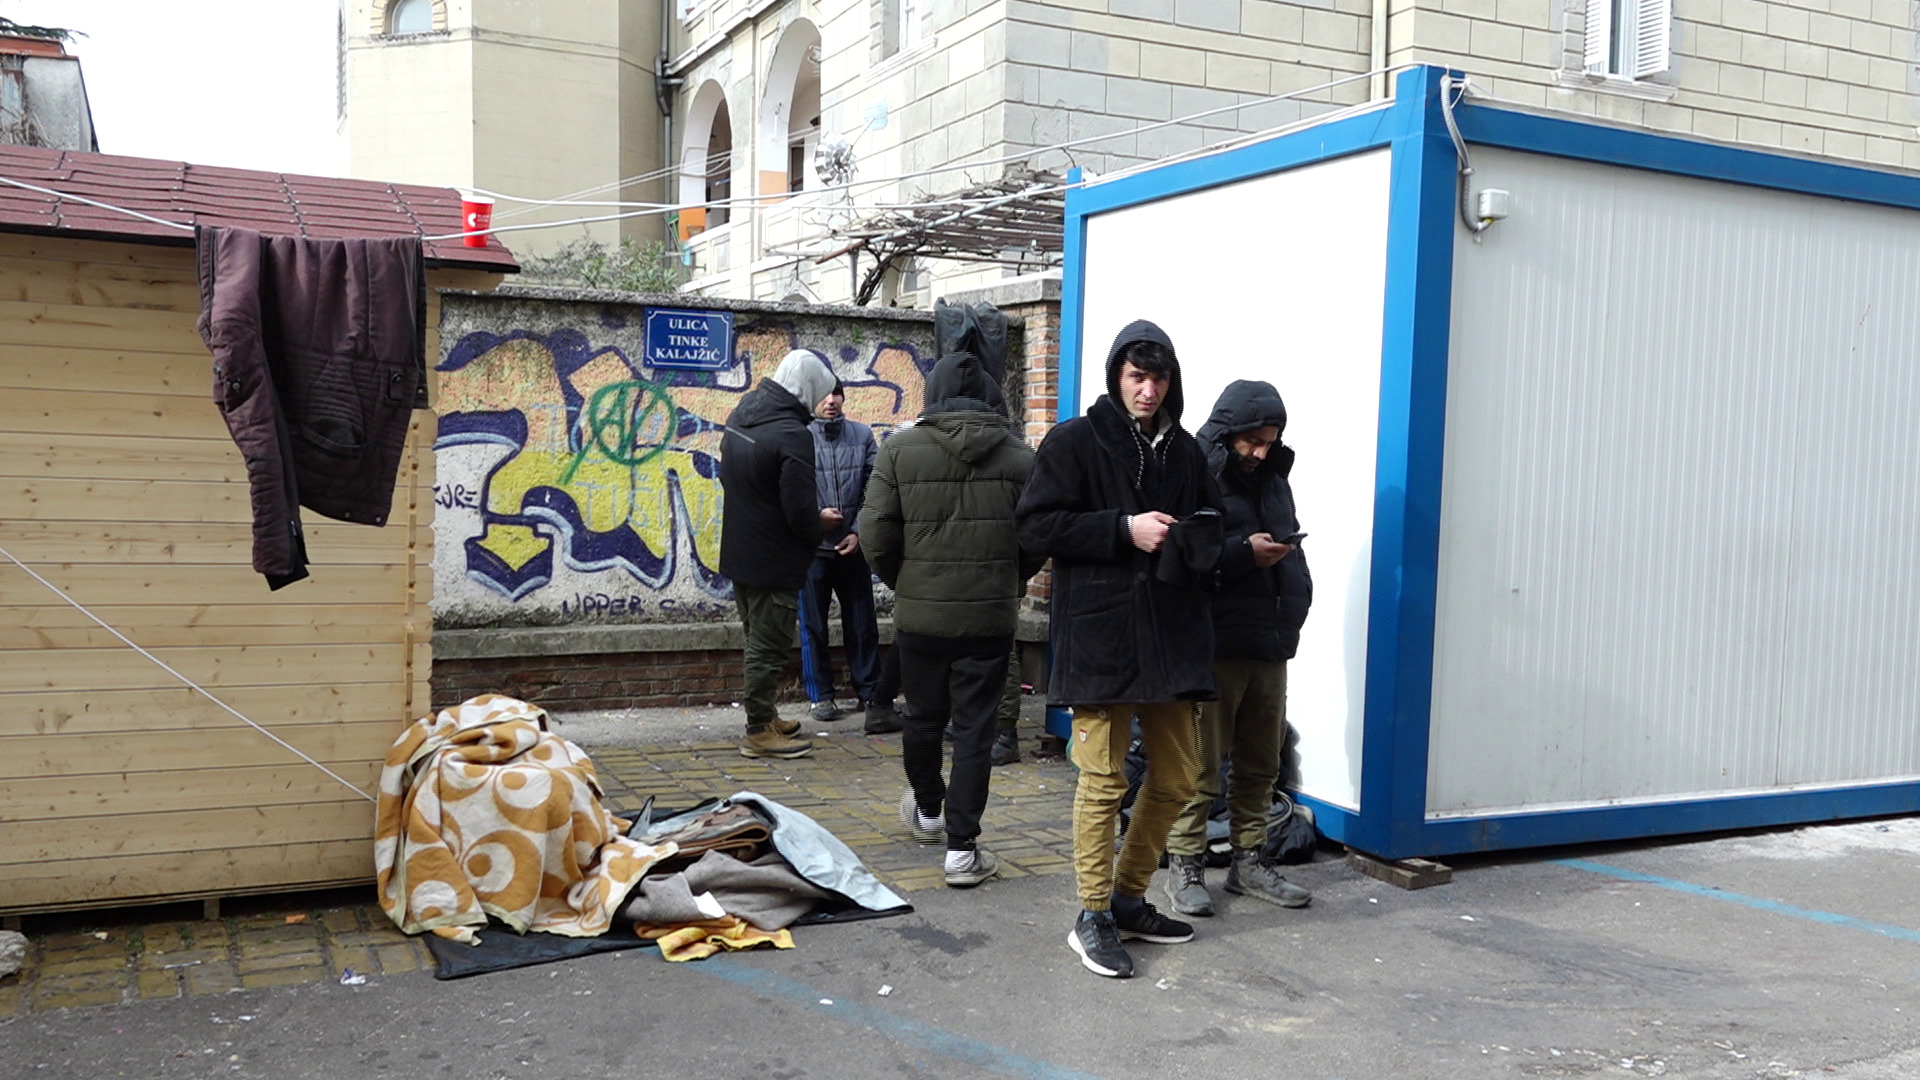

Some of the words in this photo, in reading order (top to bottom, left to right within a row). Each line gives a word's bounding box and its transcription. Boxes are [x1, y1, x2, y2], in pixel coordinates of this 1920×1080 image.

[668, 318, 709, 331] ULICA
[668, 334, 709, 348] TINKE
[655, 347, 721, 361] KALAJŽIĆ
